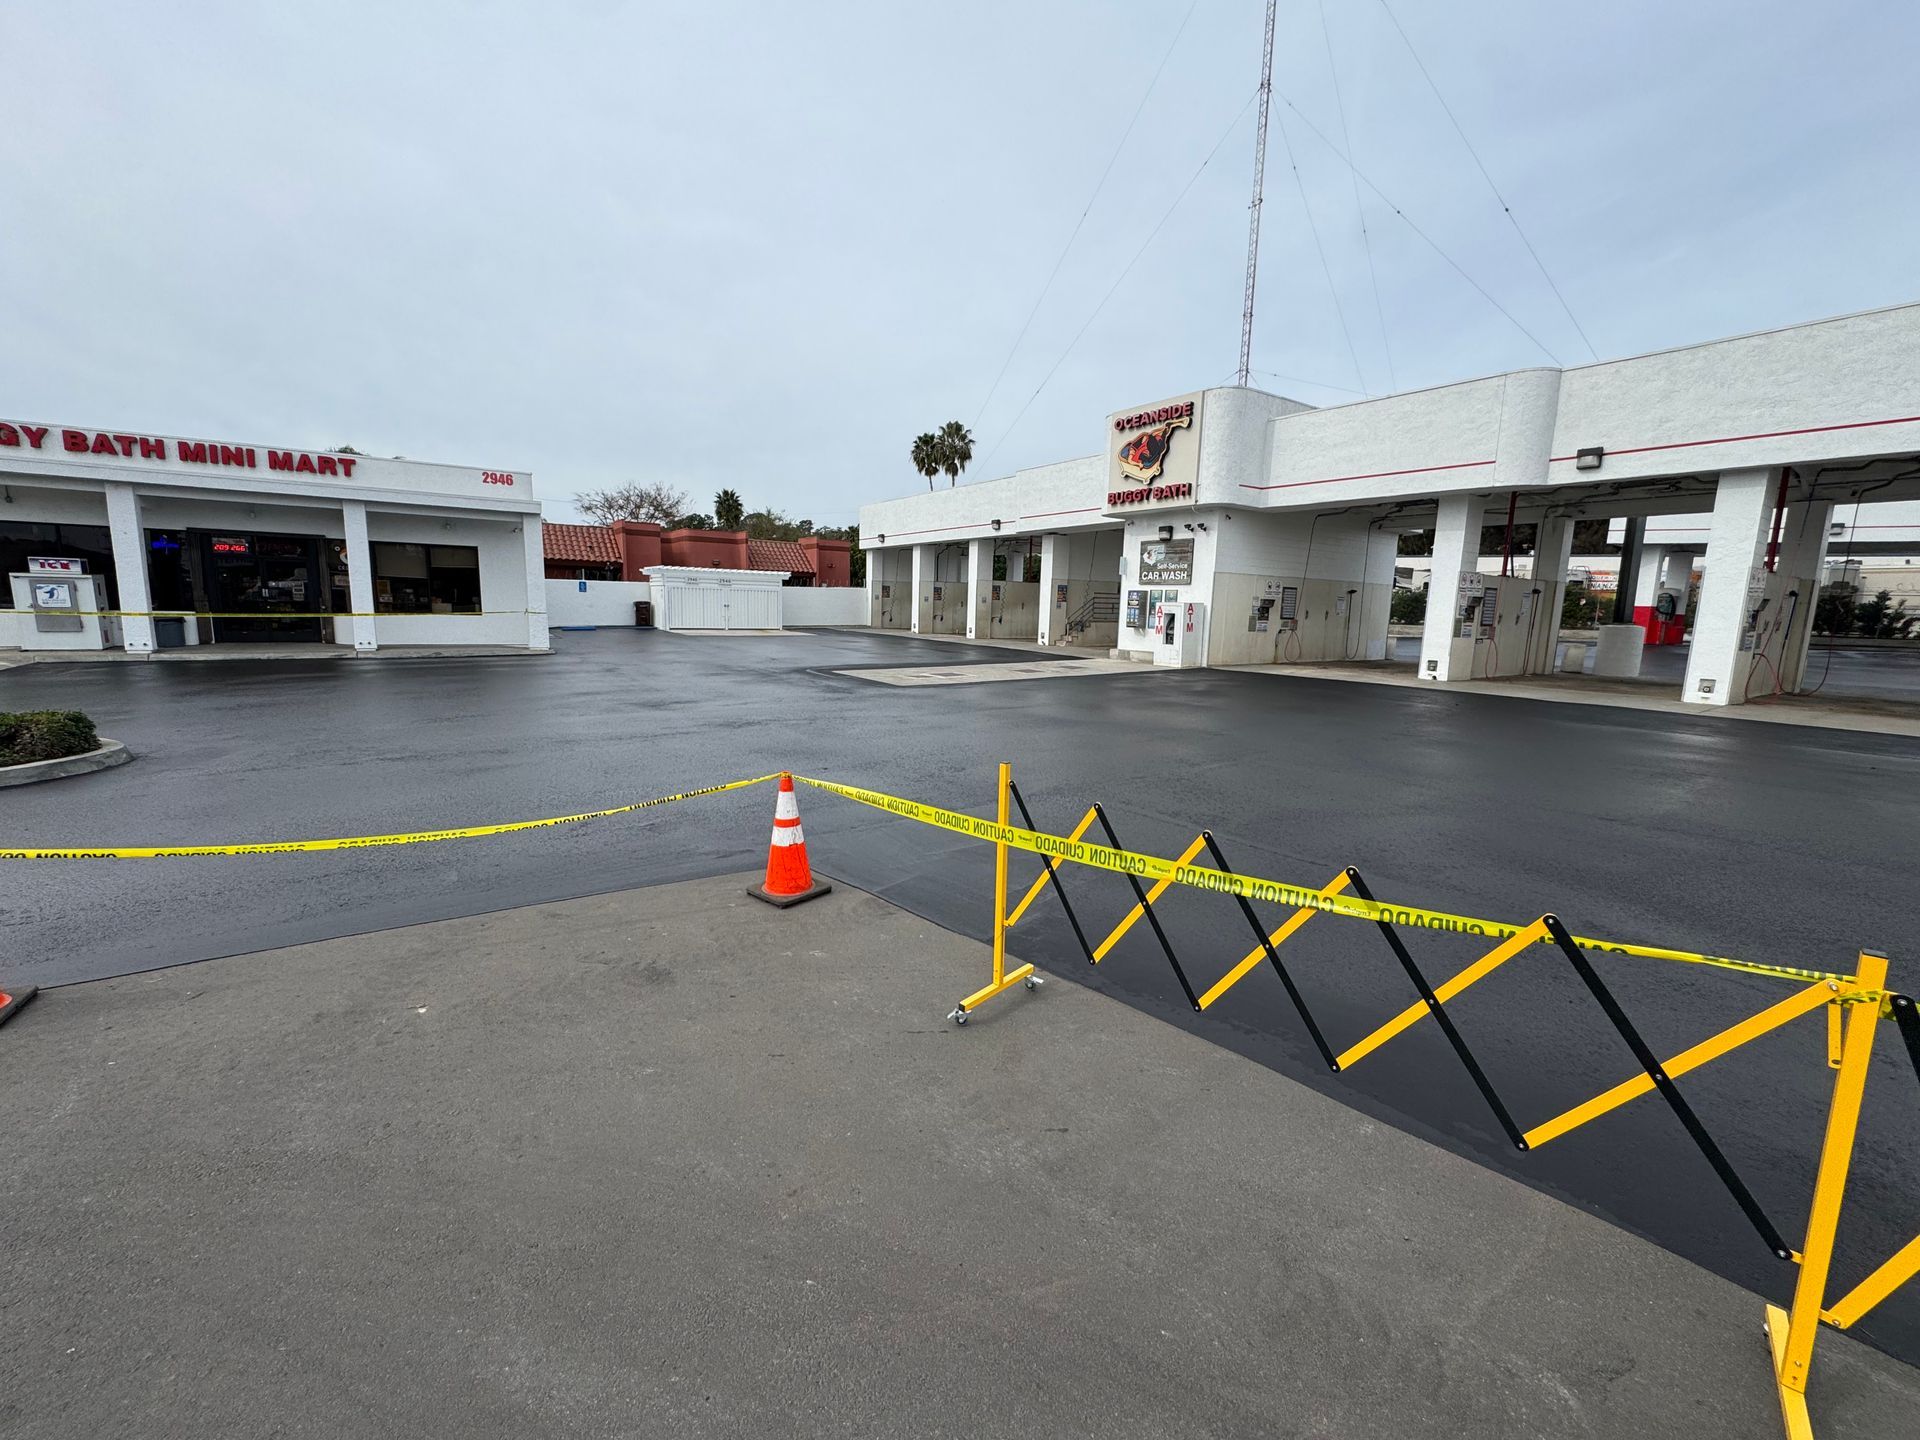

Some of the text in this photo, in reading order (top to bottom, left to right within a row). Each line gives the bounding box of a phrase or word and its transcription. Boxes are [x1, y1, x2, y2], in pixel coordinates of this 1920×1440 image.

[1114, 402, 1193, 431] OCEANSIDE
[62, 429, 166, 460] BATH
[177, 441, 256, 468] MINI
[268, 450, 356, 477] MART
[482, 471, 513, 486] 2946
[1108, 482, 1190, 505] BUGGY BATH
[39, 559, 71, 571] ICE
[1141, 570, 1187, 581] CAR WASH
